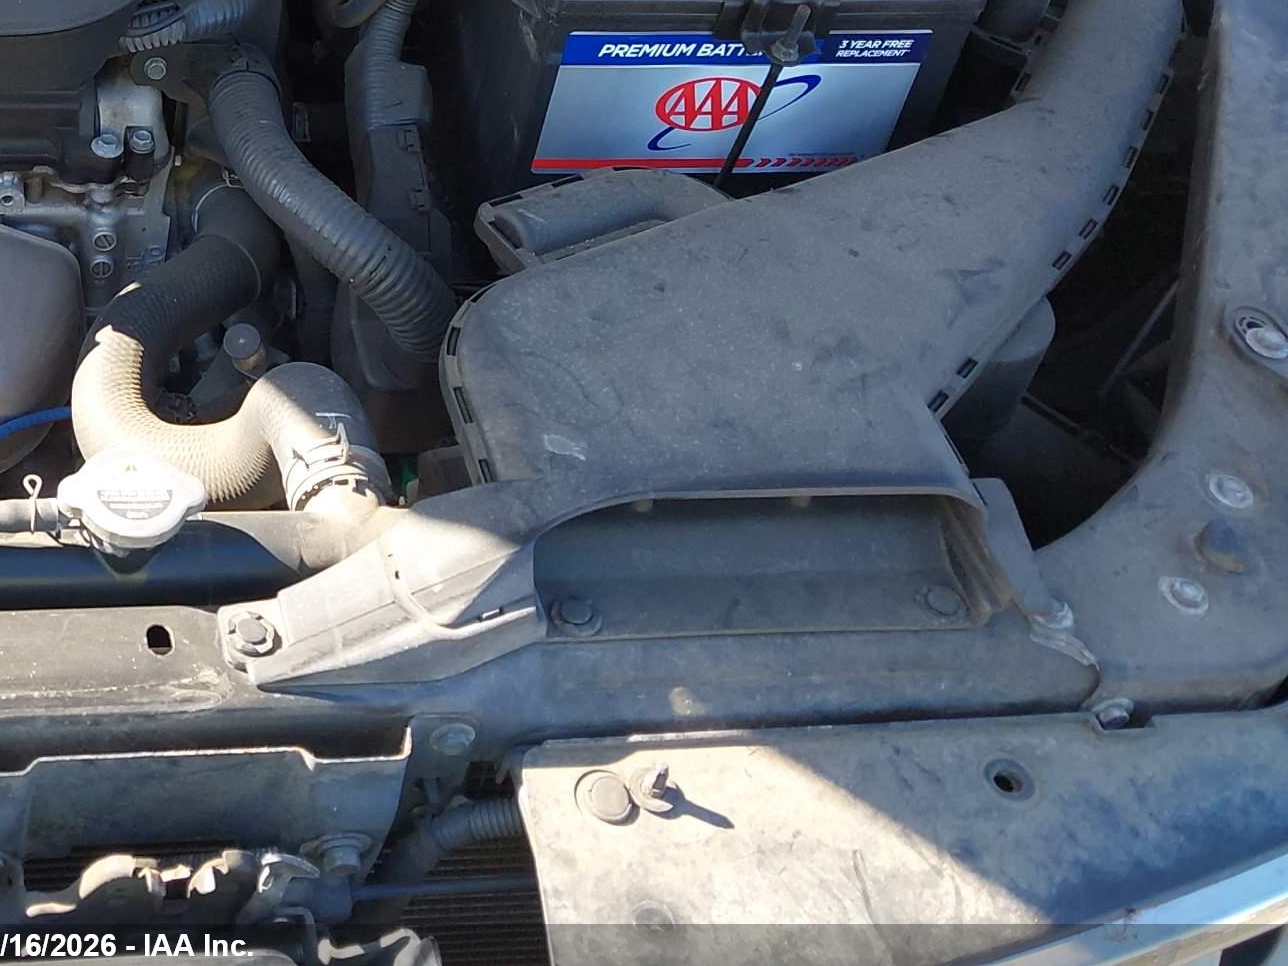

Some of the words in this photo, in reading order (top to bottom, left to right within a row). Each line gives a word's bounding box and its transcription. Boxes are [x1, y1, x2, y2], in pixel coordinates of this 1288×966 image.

[598, 43, 697, 58] PREMIUM
[696, 43, 764, 57] BATT
[839, 40, 850, 49] 3
[849, 40, 882, 49] YEAR
[881, 39, 915, 49] FREE
[656, 76, 762, 132] AAA
